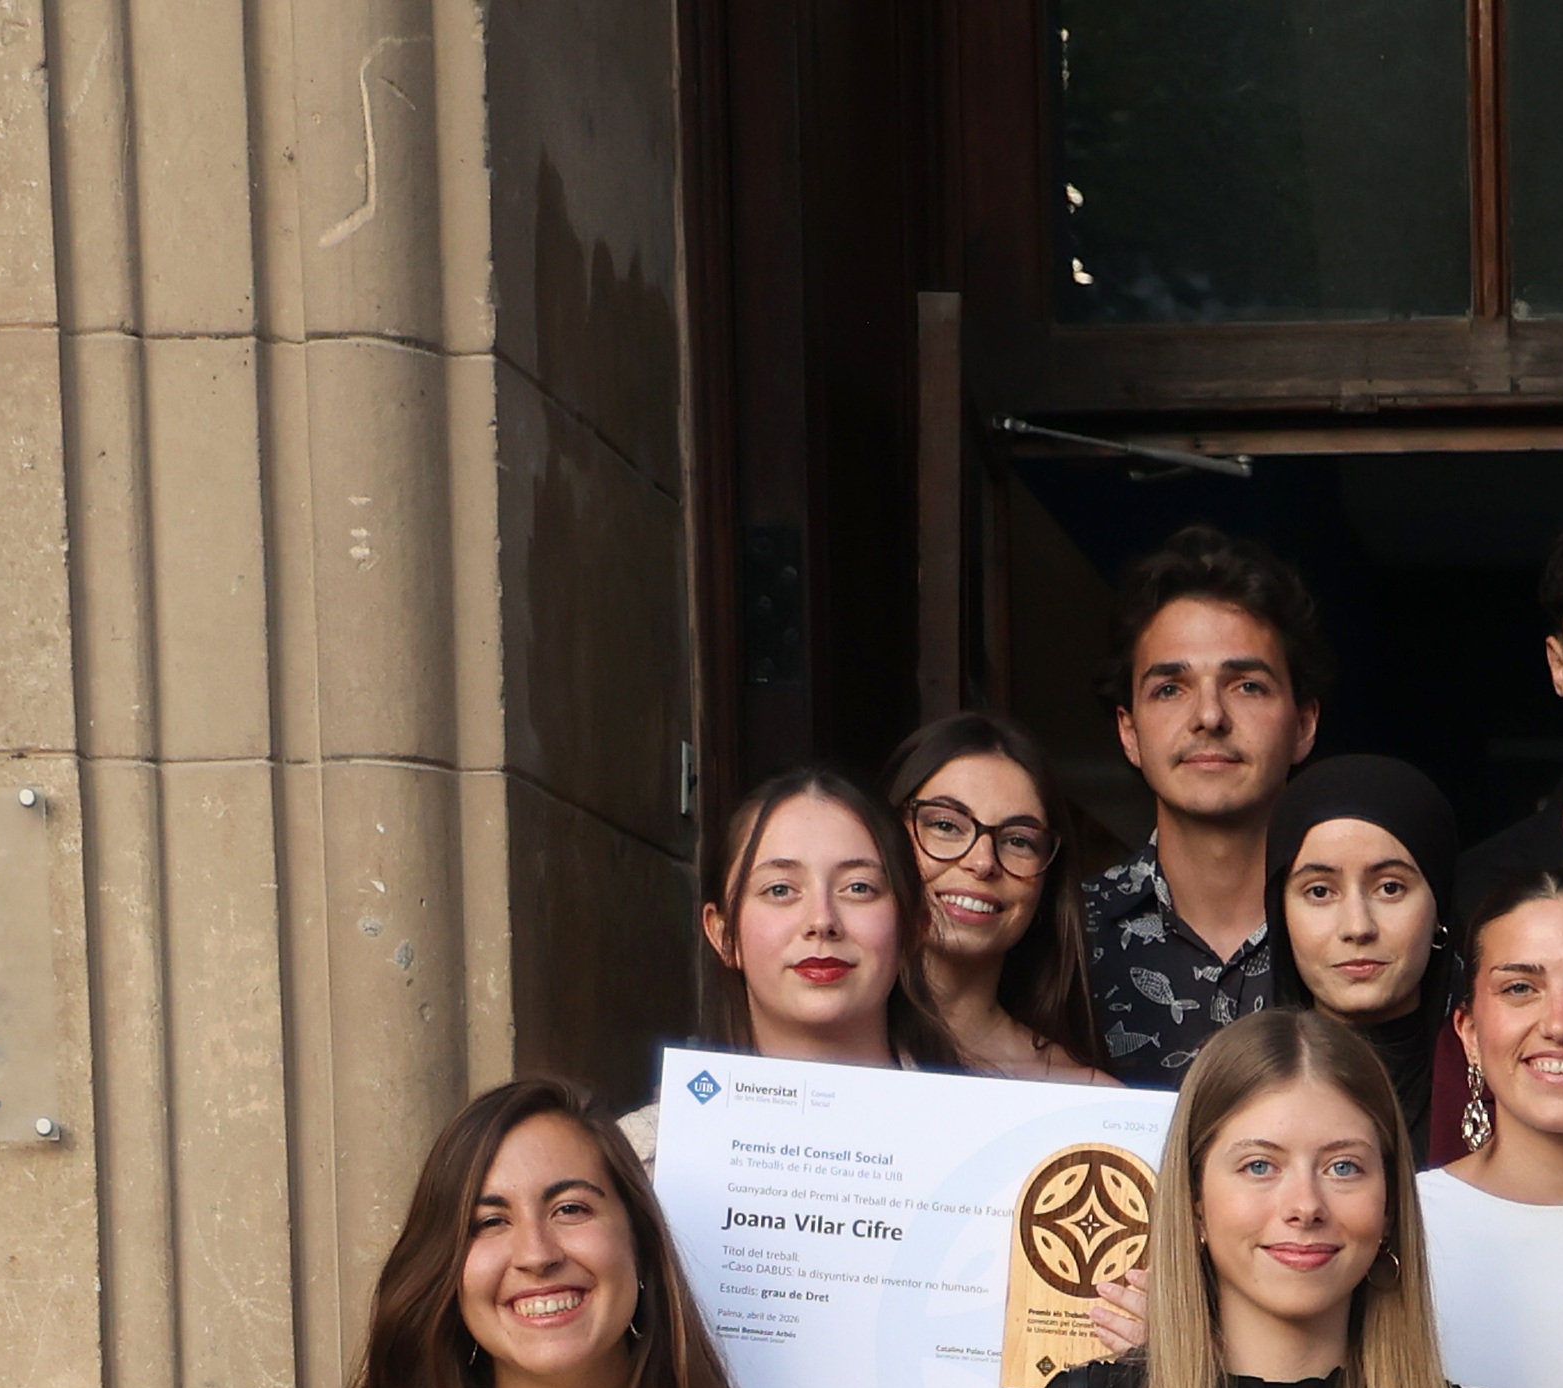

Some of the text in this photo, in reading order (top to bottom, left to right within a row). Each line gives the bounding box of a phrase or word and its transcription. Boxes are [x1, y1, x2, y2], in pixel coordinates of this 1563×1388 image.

[695, 1081, 714, 1094] UIB
[735, 1082, 798, 1098] Universitat
[720, 1207, 903, 1241] Joana Vilar Cifre
[719, 1283, 829, 1303] Estudis: grau de Dret
